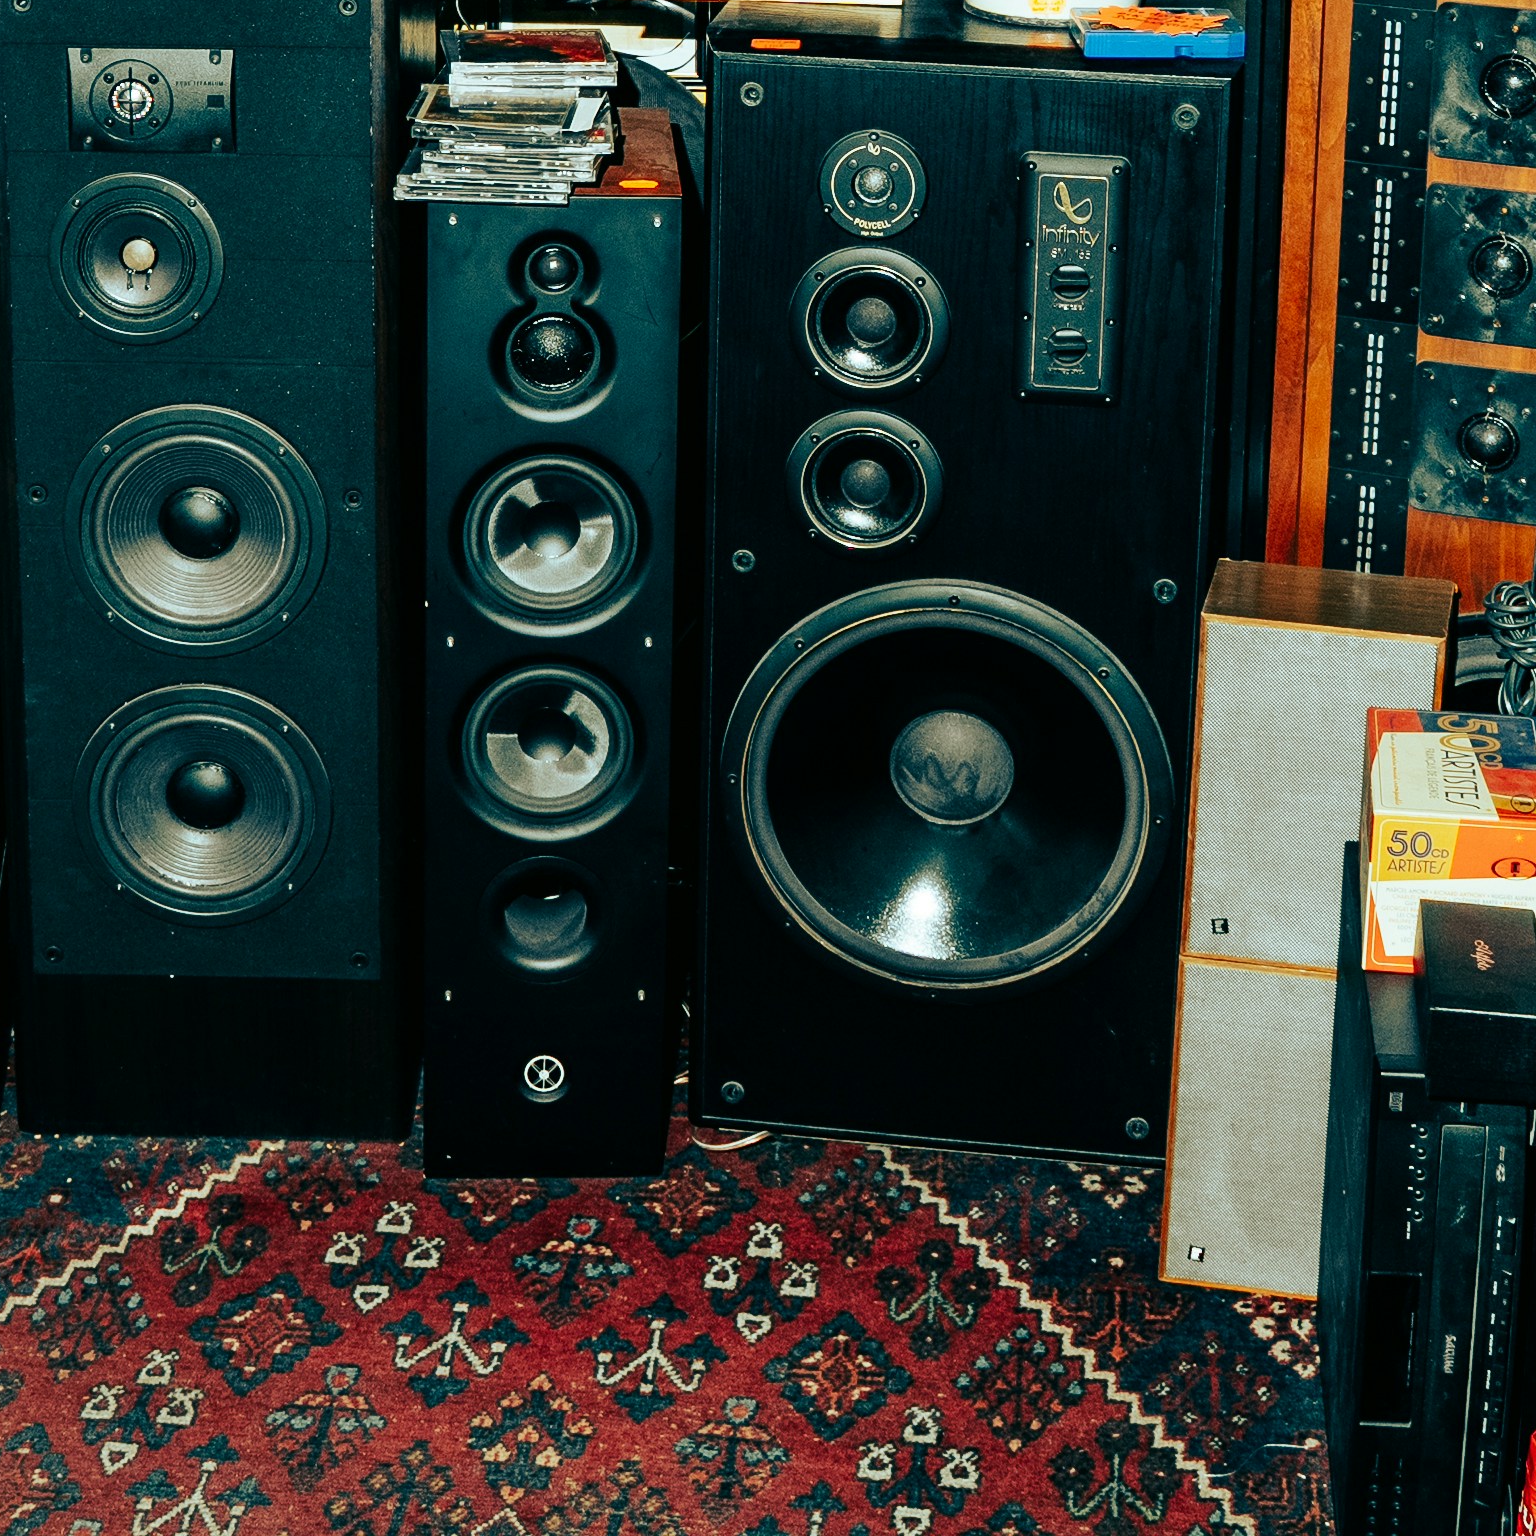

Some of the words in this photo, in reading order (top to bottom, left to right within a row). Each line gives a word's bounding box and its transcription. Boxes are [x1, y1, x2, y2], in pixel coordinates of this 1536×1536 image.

[854, 217, 892, 230] POLYCELL
[1042, 224, 1100, 247] infinity
[1437, 715, 1501, 754] 50
[1479, 753, 1503, 770] CD
[1440, 748, 1481, 810] ARTISTES
[1387, 830, 1432, 858] 50
[1431, 848, 1449, 859] CD
[1387, 858, 1447, 874] ARTISTES
[1444, 1334, 1457, 1373] PHILIPS
